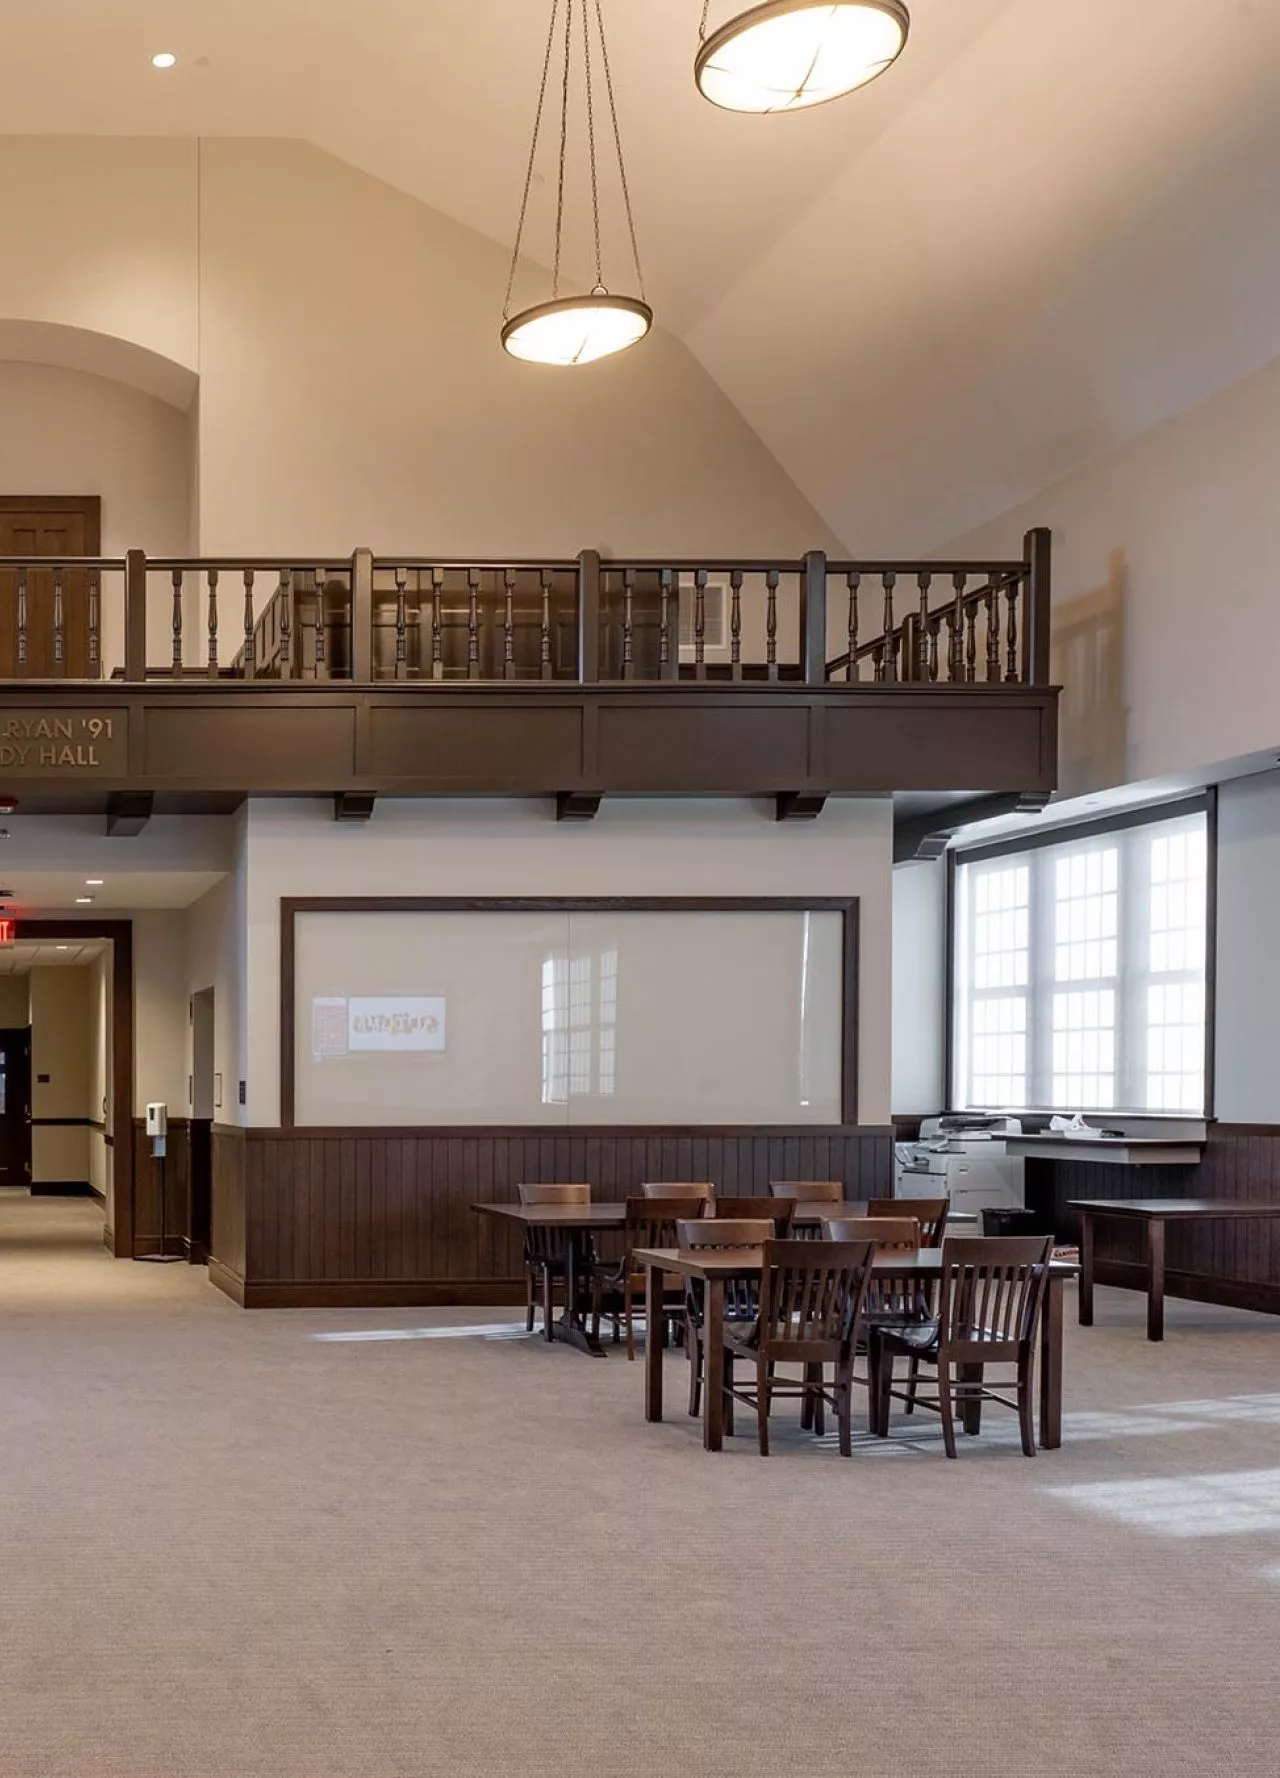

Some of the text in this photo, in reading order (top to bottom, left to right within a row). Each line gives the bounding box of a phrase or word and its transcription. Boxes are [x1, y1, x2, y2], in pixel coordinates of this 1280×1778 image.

[7, 718, 72, 739] RYAN
[81, 717, 112, 739] '91
[39, 745, 99, 766] HALL
